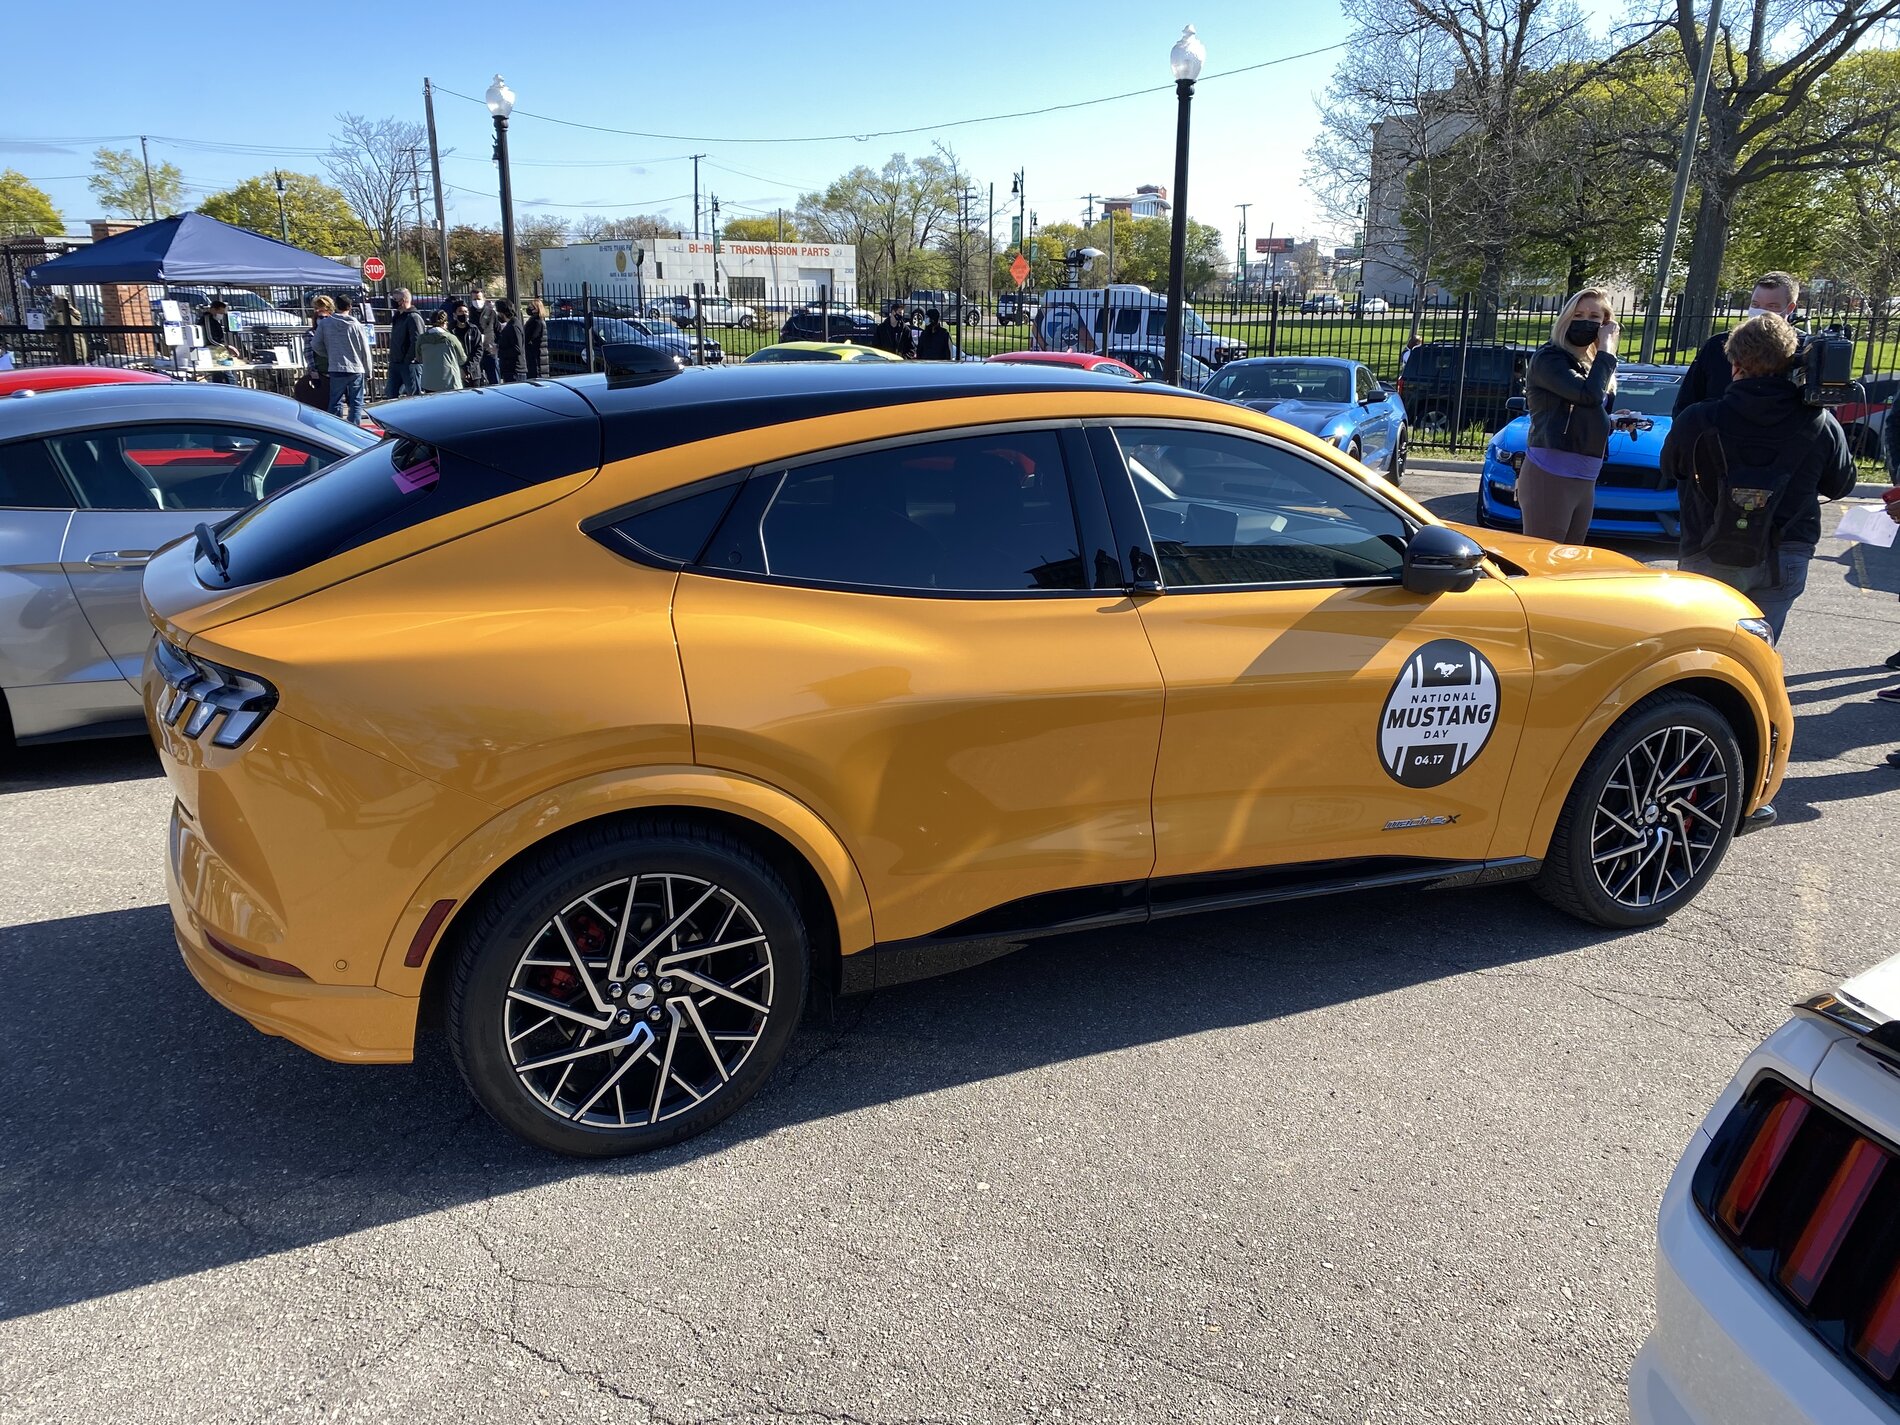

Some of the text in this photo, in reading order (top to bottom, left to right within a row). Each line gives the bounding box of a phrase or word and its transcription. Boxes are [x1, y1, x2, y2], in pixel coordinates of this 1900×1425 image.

[688, 243, 830, 257] BI-RIE TRANSMISSION PARTS
[366, 264, 384, 274] STOP
[1411, 692, 1477, 703] NATIONAL
[1386, 704, 1491, 728] MUSTANG
[1424, 730, 1448, 739] DAY
[1414, 755, 1444, 765] 04.17
